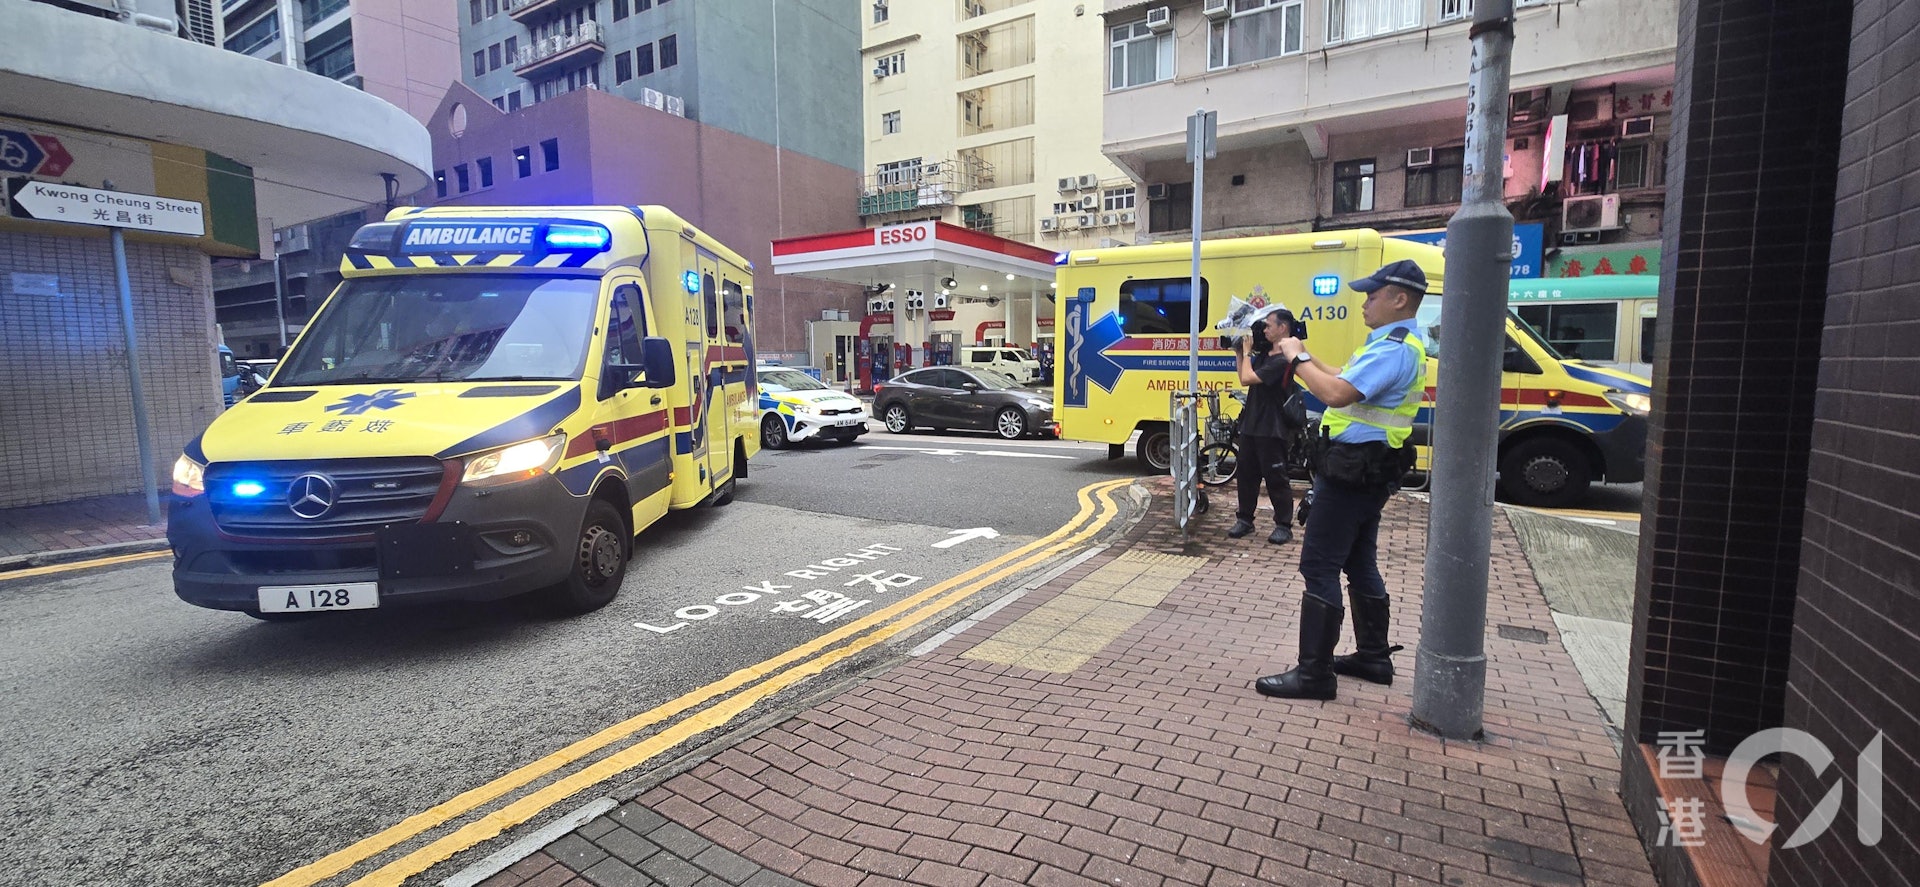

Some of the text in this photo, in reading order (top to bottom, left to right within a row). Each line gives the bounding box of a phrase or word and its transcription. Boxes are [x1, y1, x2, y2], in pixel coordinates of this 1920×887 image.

[35, 186, 199, 214] Kwong Cheung Street
[57, 206, 153, 226] 3 光昌街
[406, 227, 534, 245] AMBULANCE
[881, 226, 926, 245] ESSO
[685, 306, 699, 326] A128
[1300, 305, 1347, 320] A130
[634, 543, 901, 633] LOOK RIGHT
[770, 570, 923, 624] 望右
[286, 588, 350, 609] A 128
